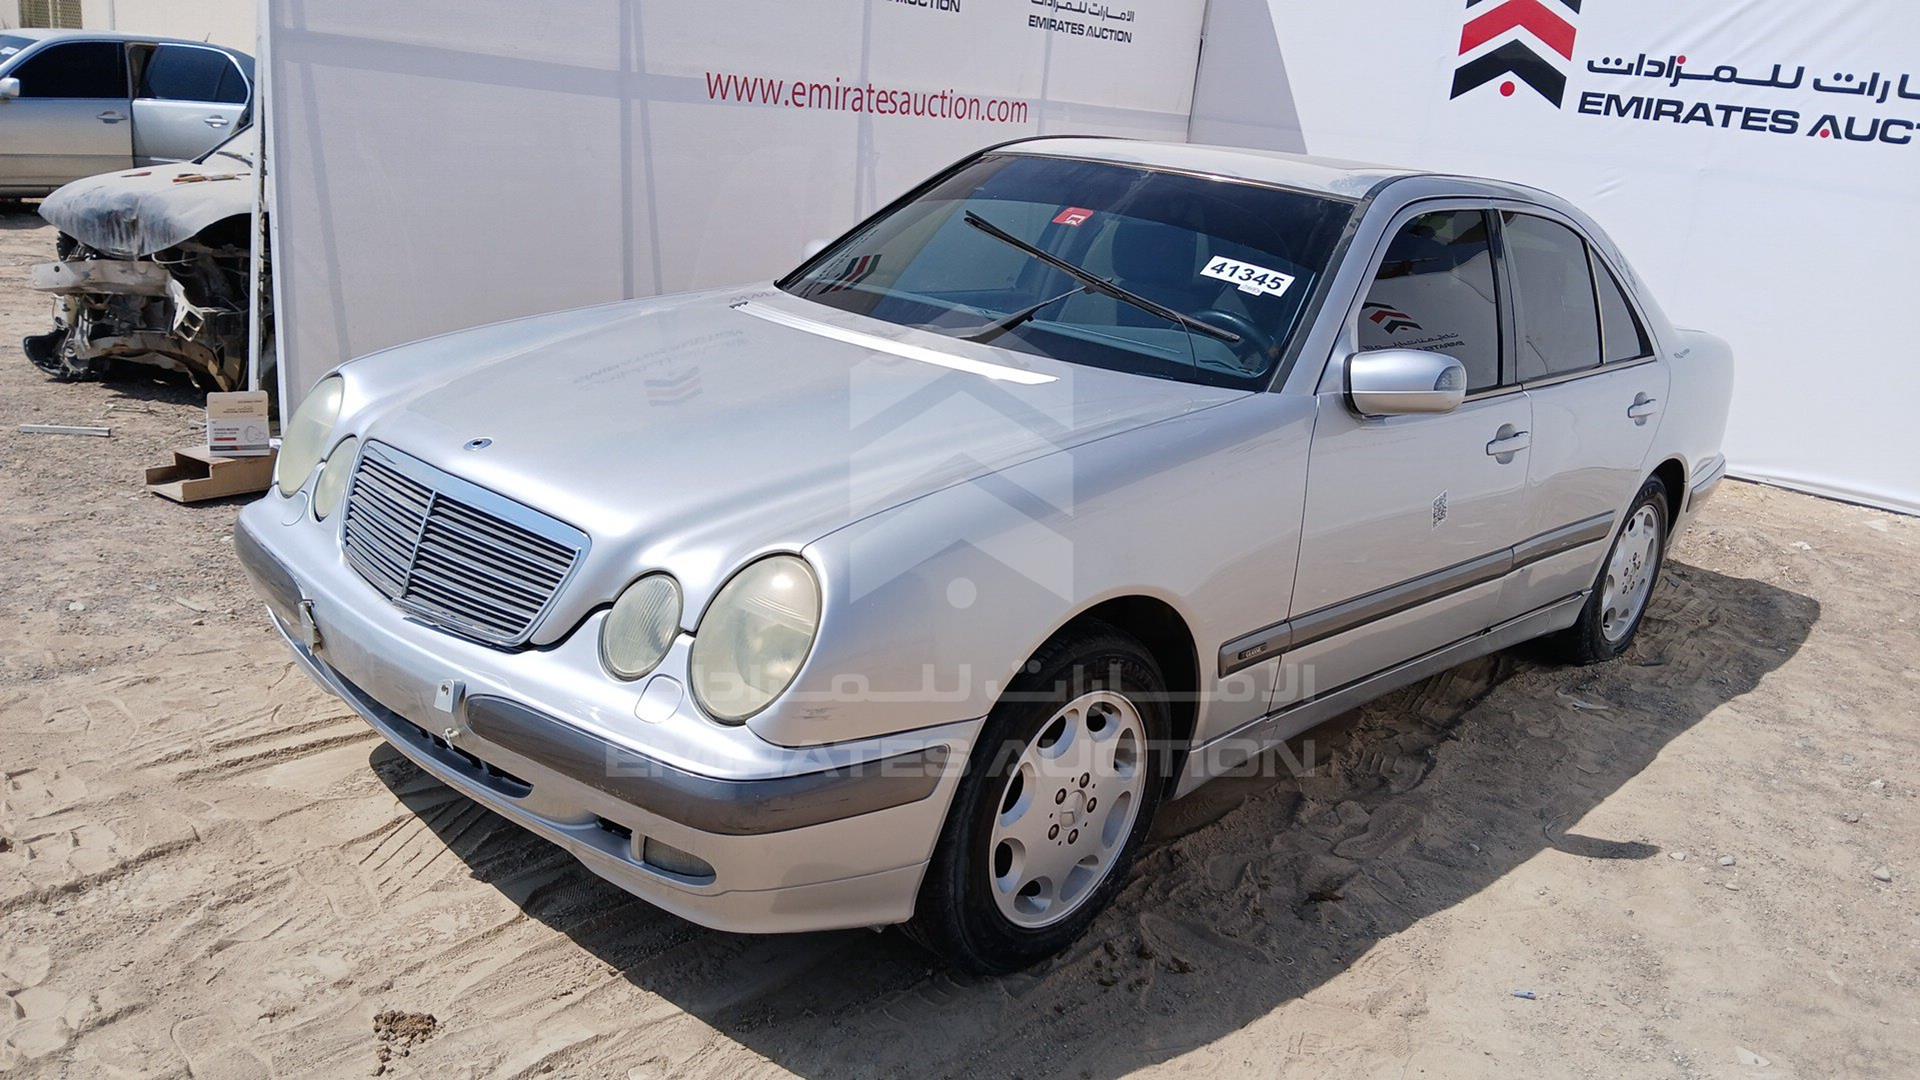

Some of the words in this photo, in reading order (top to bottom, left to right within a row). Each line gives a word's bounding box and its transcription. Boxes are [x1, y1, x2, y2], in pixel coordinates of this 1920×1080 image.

[896, 0, 960, 12] CTION
[1028, 14, 1085, 36] EMIRATES
[1086, 26, 1133, 43] AUCTION
[706, 72, 1029, 123] www.emiratesauction.com
[1577, 91, 1800, 134] EMIRATES
[1806, 114, 1920, 145] AUC
[1210, 262, 1285, 290] 41345
